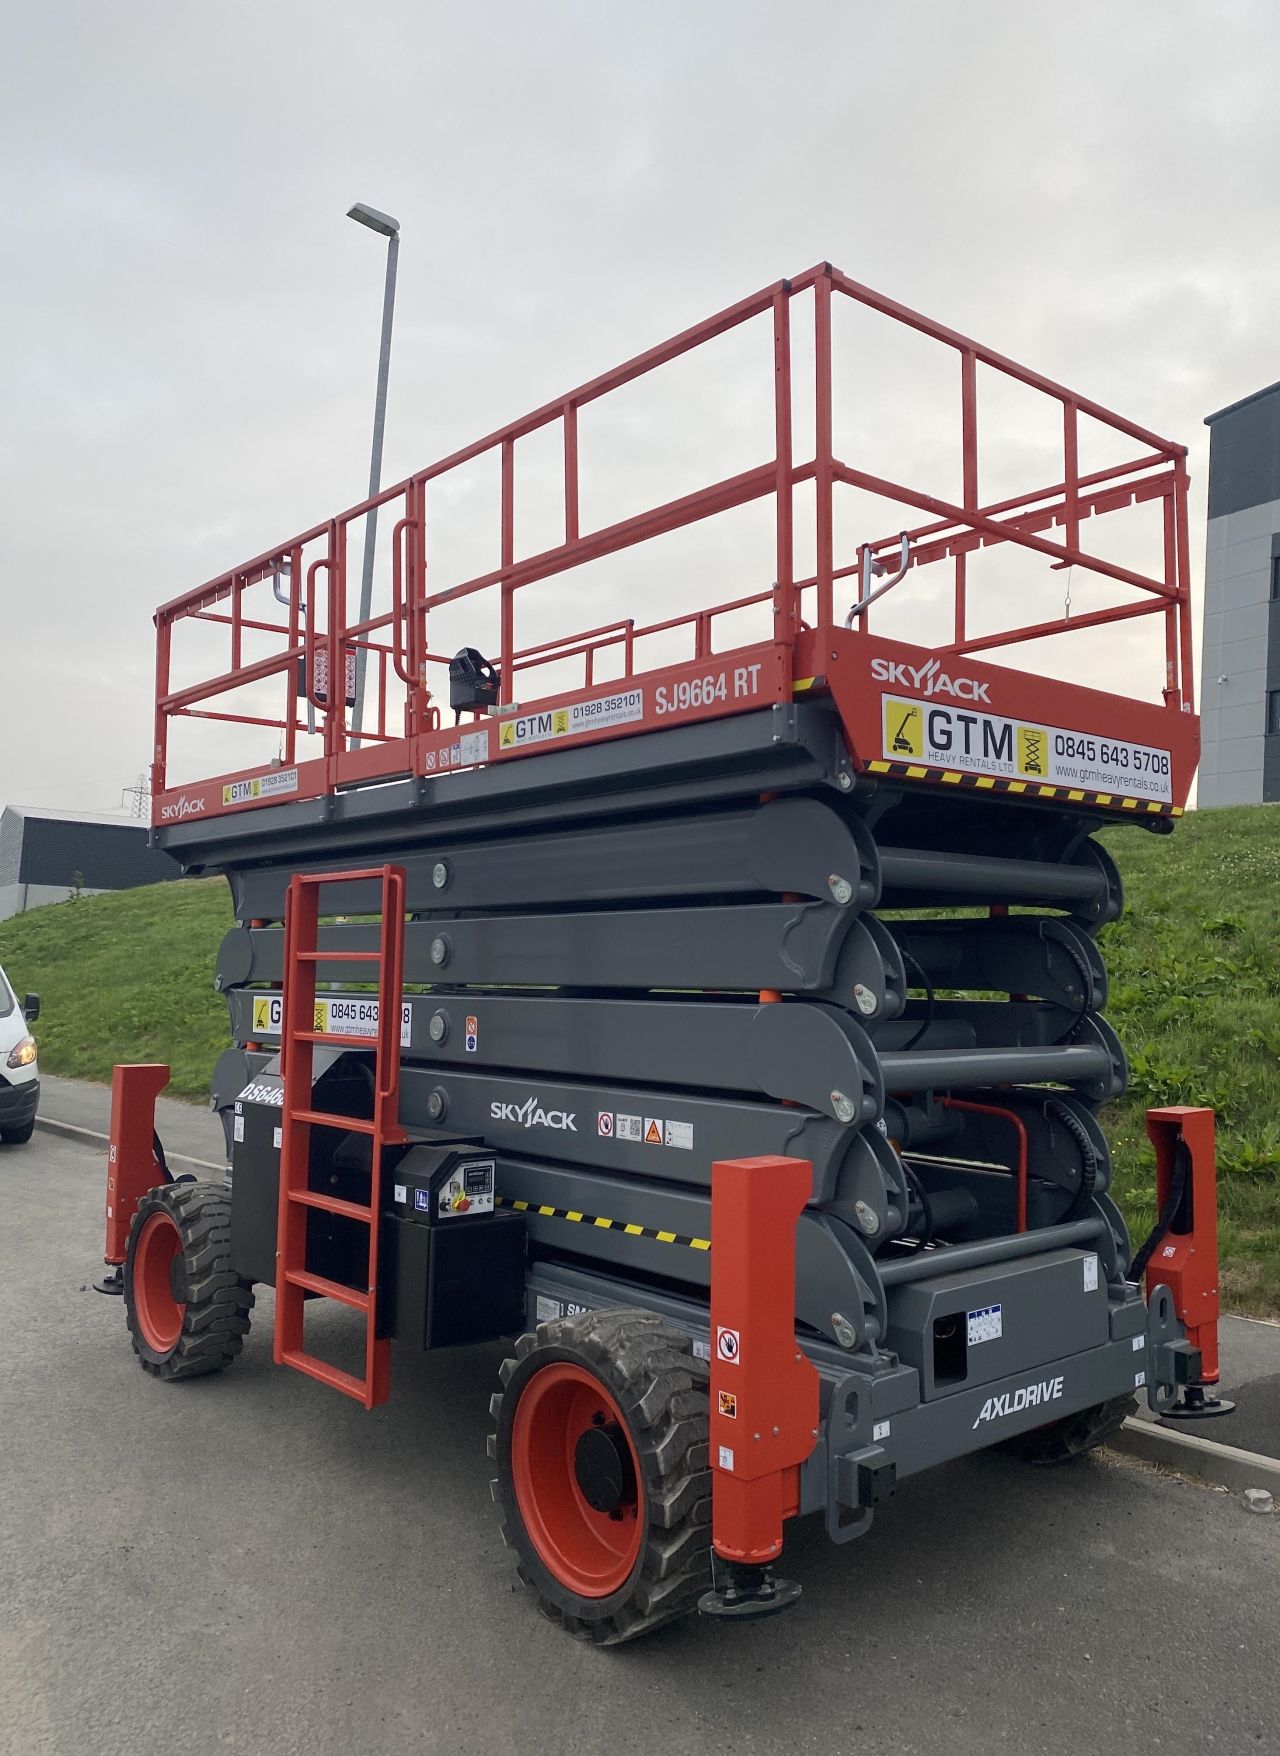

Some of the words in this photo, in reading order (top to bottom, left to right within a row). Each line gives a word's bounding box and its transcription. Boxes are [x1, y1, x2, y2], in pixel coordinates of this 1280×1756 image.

[655, 672, 728, 715] SJ9664
[734, 663, 762, 698] RT
[871, 657, 991, 704] SKYJACK
[573, 703, 602, 719] 01928
[604, 693, 641, 711] 352101
[515, 713, 552, 739] GTM
[928, 709, 1014, 762] GTM
[928, 751, 957, 763] HEAVY
[959, 755, 997, 771] RENTALS
[999, 761, 1014, 773] LTD
[1055, 735, 1096, 762] 0845
[1100, 743, 1129, 768] 643
[1133, 750, 1169, 775] 5708
[231, 781, 252, 799] GTM
[261, 775, 278, 787] 01928
[278, 771, 297, 784] 352101
[1055, 765, 1170, 794] www.gtmheavyrentals.co.uk
[161, 794, 205, 819] SKYJACK
[331, 1003, 357, 1020] 0845
[359, 1005, 379, 1022] 643
[490, 1096, 578, 1132] SKYJACK
[972, 1376, 1065, 1430] AXLDRIVE
